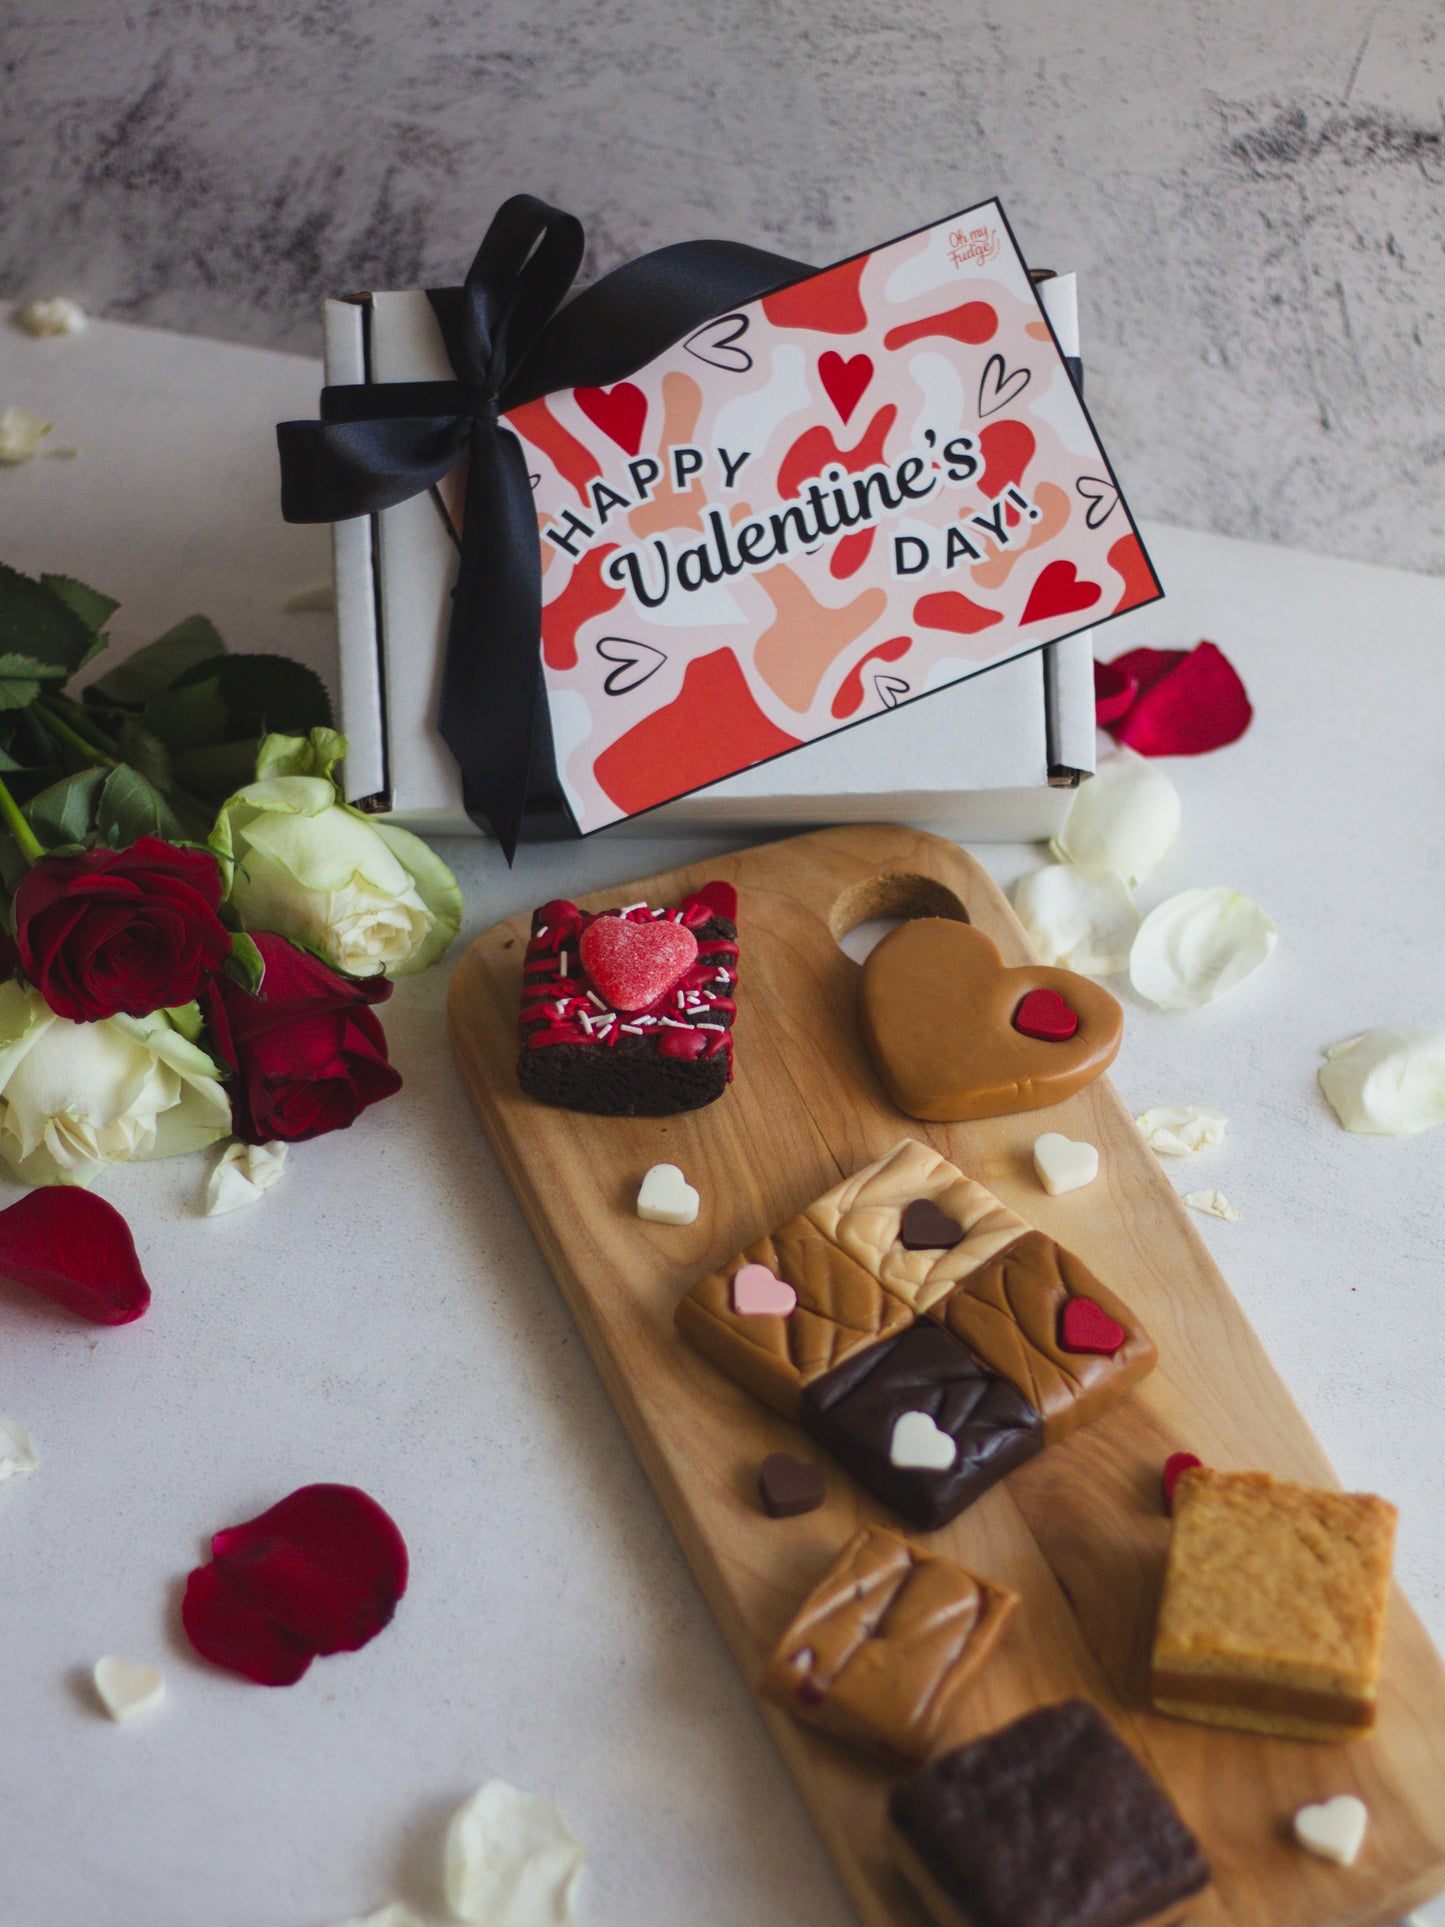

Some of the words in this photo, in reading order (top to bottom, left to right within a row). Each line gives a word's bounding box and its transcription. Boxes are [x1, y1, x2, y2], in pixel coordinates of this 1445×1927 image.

[949, 229, 967, 248] Oh
[970, 226, 989, 242] my
[546, 448, 751, 557] HAPPY
[610, 429, 978, 608] Valentine's
[895, 488, 1039, 576] DAY!
